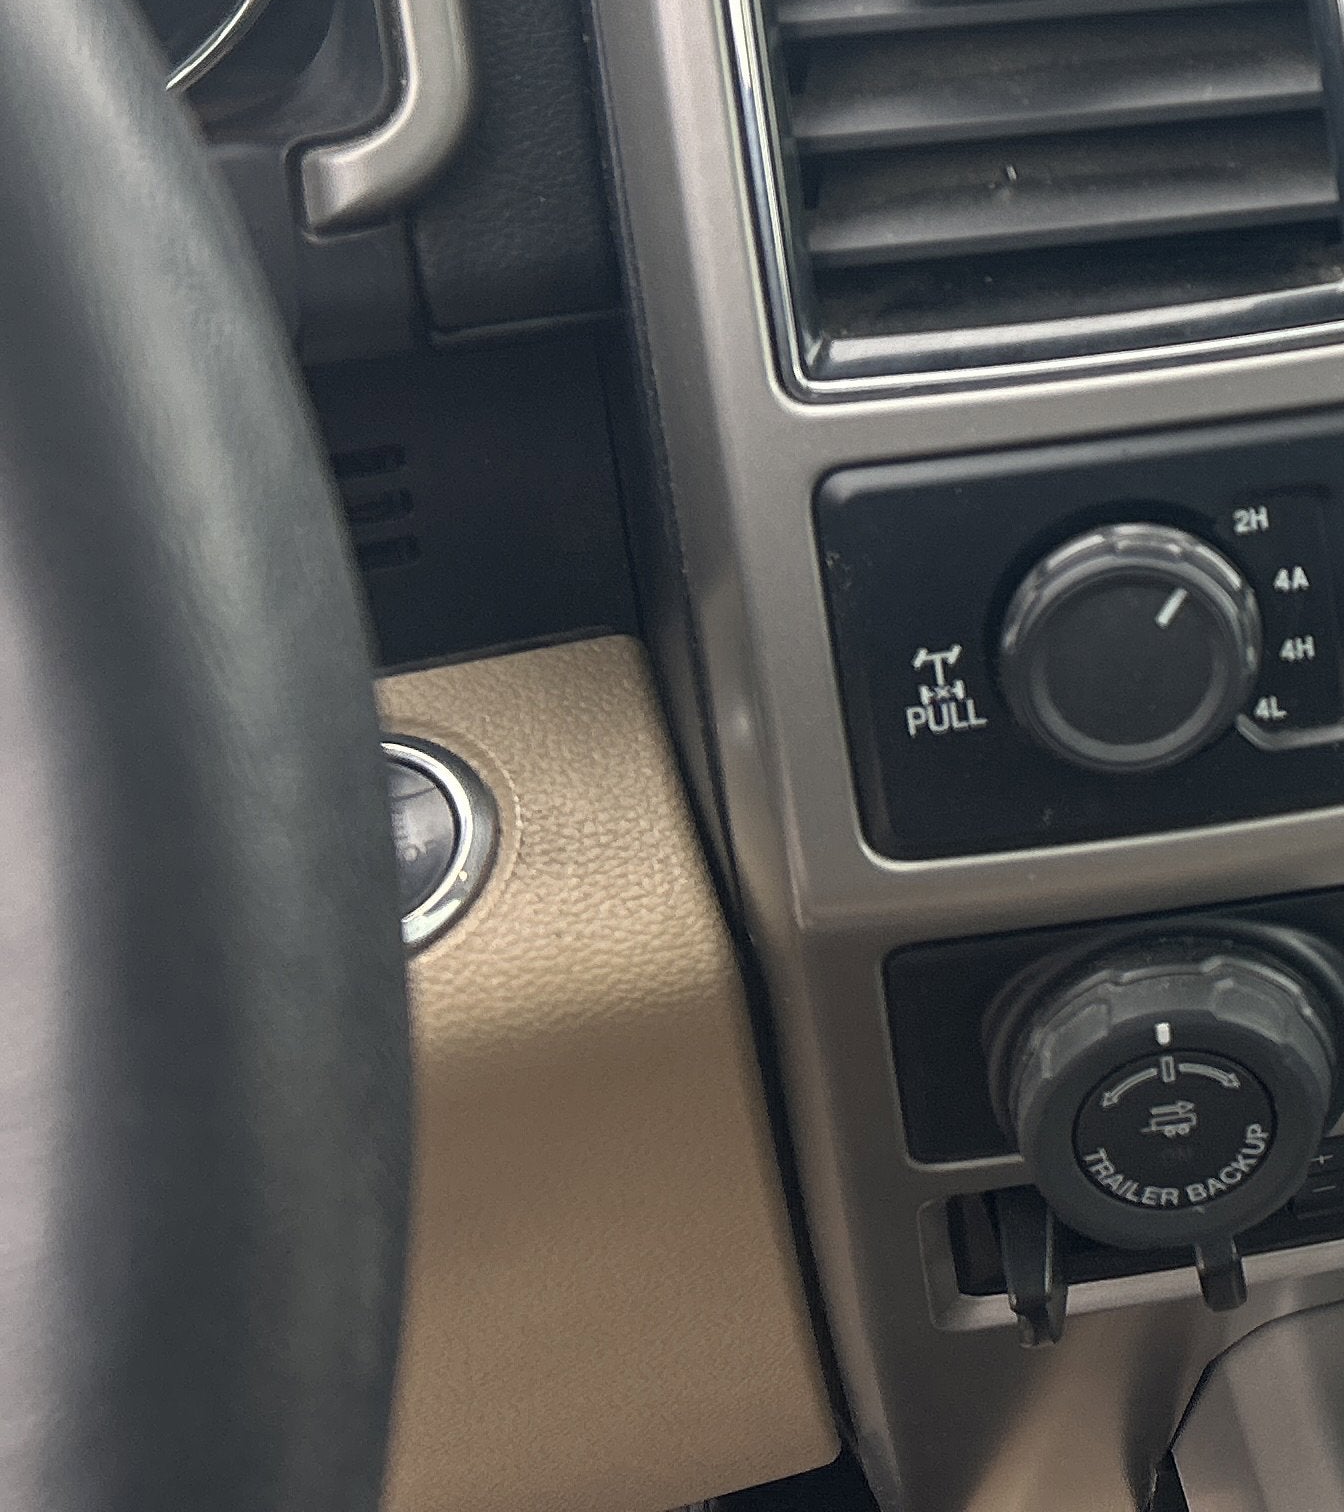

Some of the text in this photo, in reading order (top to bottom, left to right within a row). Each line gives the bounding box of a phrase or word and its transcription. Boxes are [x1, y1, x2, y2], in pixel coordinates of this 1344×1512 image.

[1231, 504, 1270, 534] 2H
[1273, 565, 1310, 592] 4A
[1279, 633, 1316, 663] 4H
[905, 699, 988, 737] PULL
[1253, 695, 1288, 721] 4L
[1084, 1123, 1269, 1207] TRAILER BACKUP
